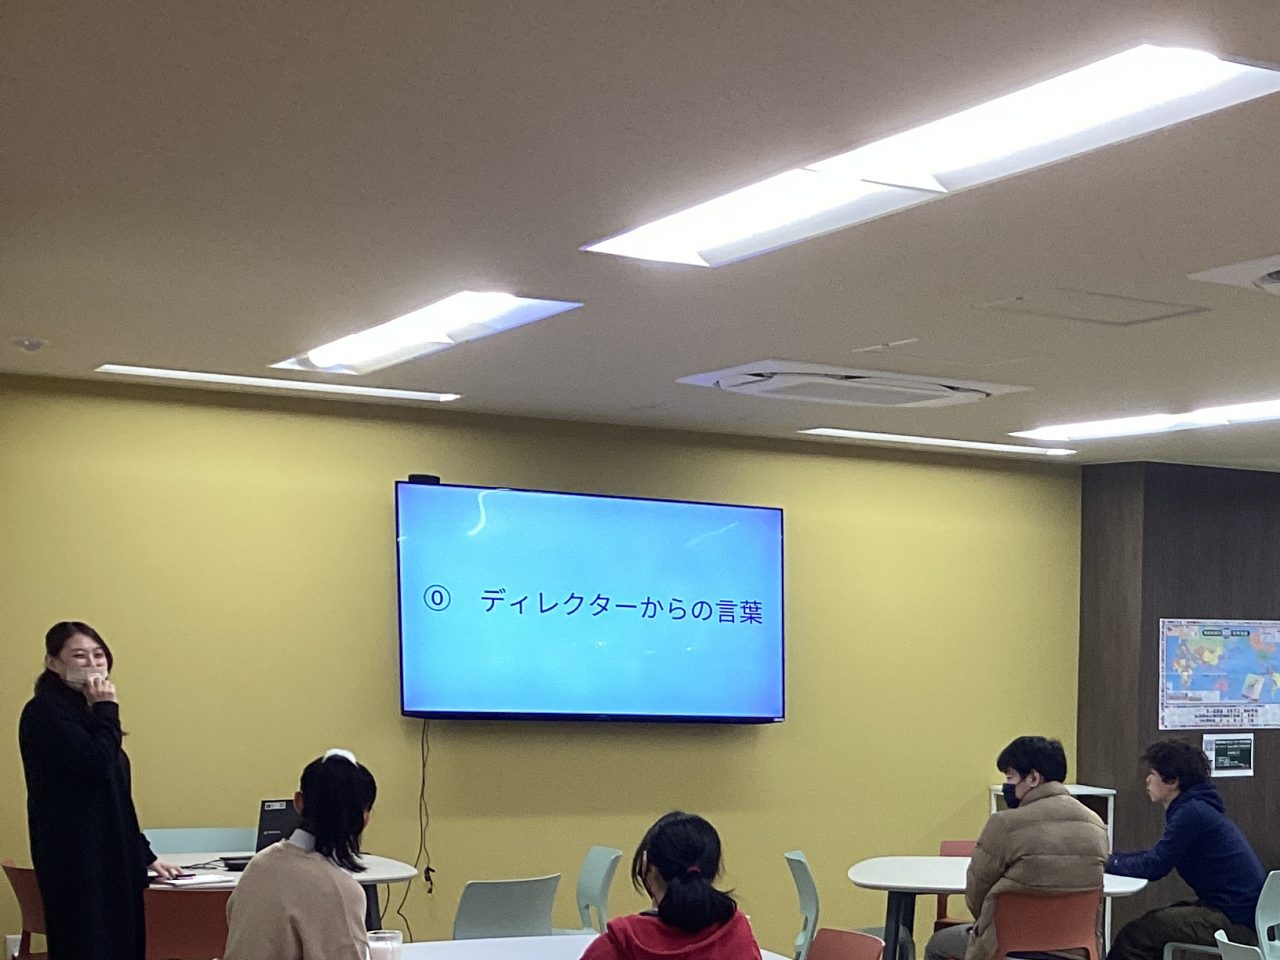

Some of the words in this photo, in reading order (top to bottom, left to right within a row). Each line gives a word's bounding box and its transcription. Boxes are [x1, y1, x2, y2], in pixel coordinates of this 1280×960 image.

[481, 588, 763, 624] ディレクターからの言葉
